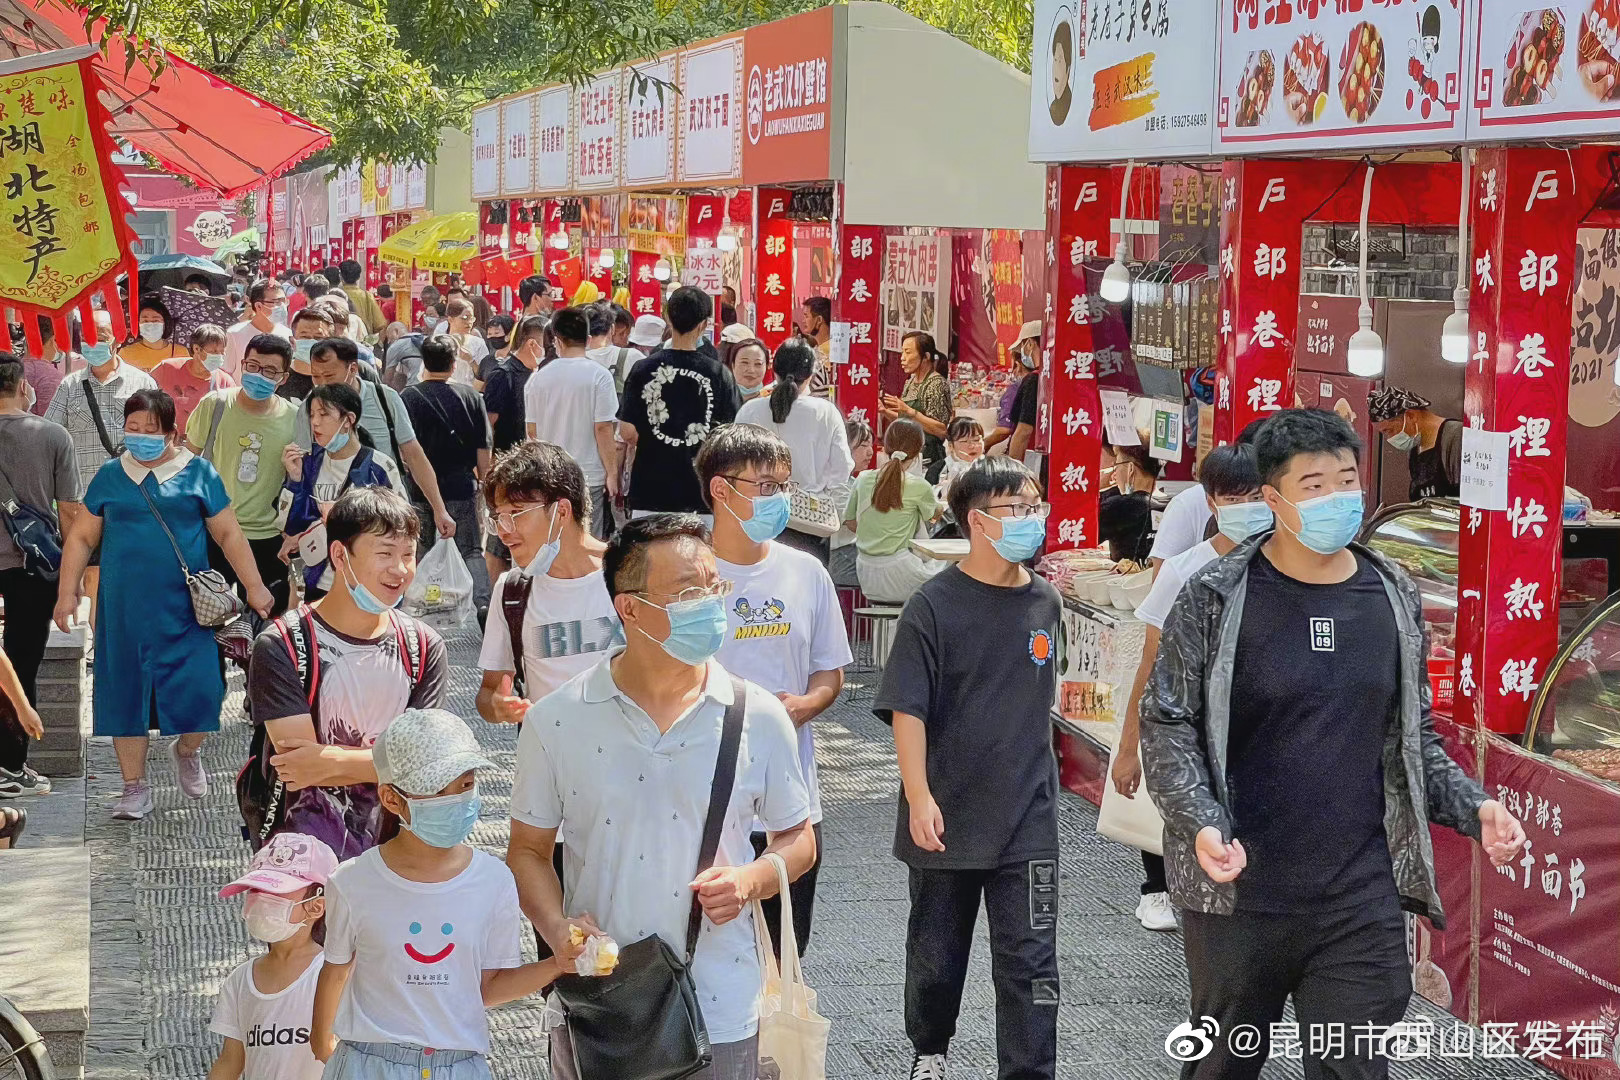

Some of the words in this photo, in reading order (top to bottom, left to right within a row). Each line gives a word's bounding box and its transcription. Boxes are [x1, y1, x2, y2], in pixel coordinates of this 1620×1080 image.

[764, 57, 827, 112] 老武汉虾蟹馆
[65, 133, 100, 236] 全场包邮
[0, 121, 67, 285] 湖北特产
[691, 253, 720, 271] 冰水
[887, 240, 937, 287] 蒙古大肉串
[692, 274, 720, 290] 2元
[1572, 357, 1603, 385] 2021
[735, 622, 791, 640] MINION
[1315, 621, 1331, 634] 06
[1315, 636, 1331, 647] 09
